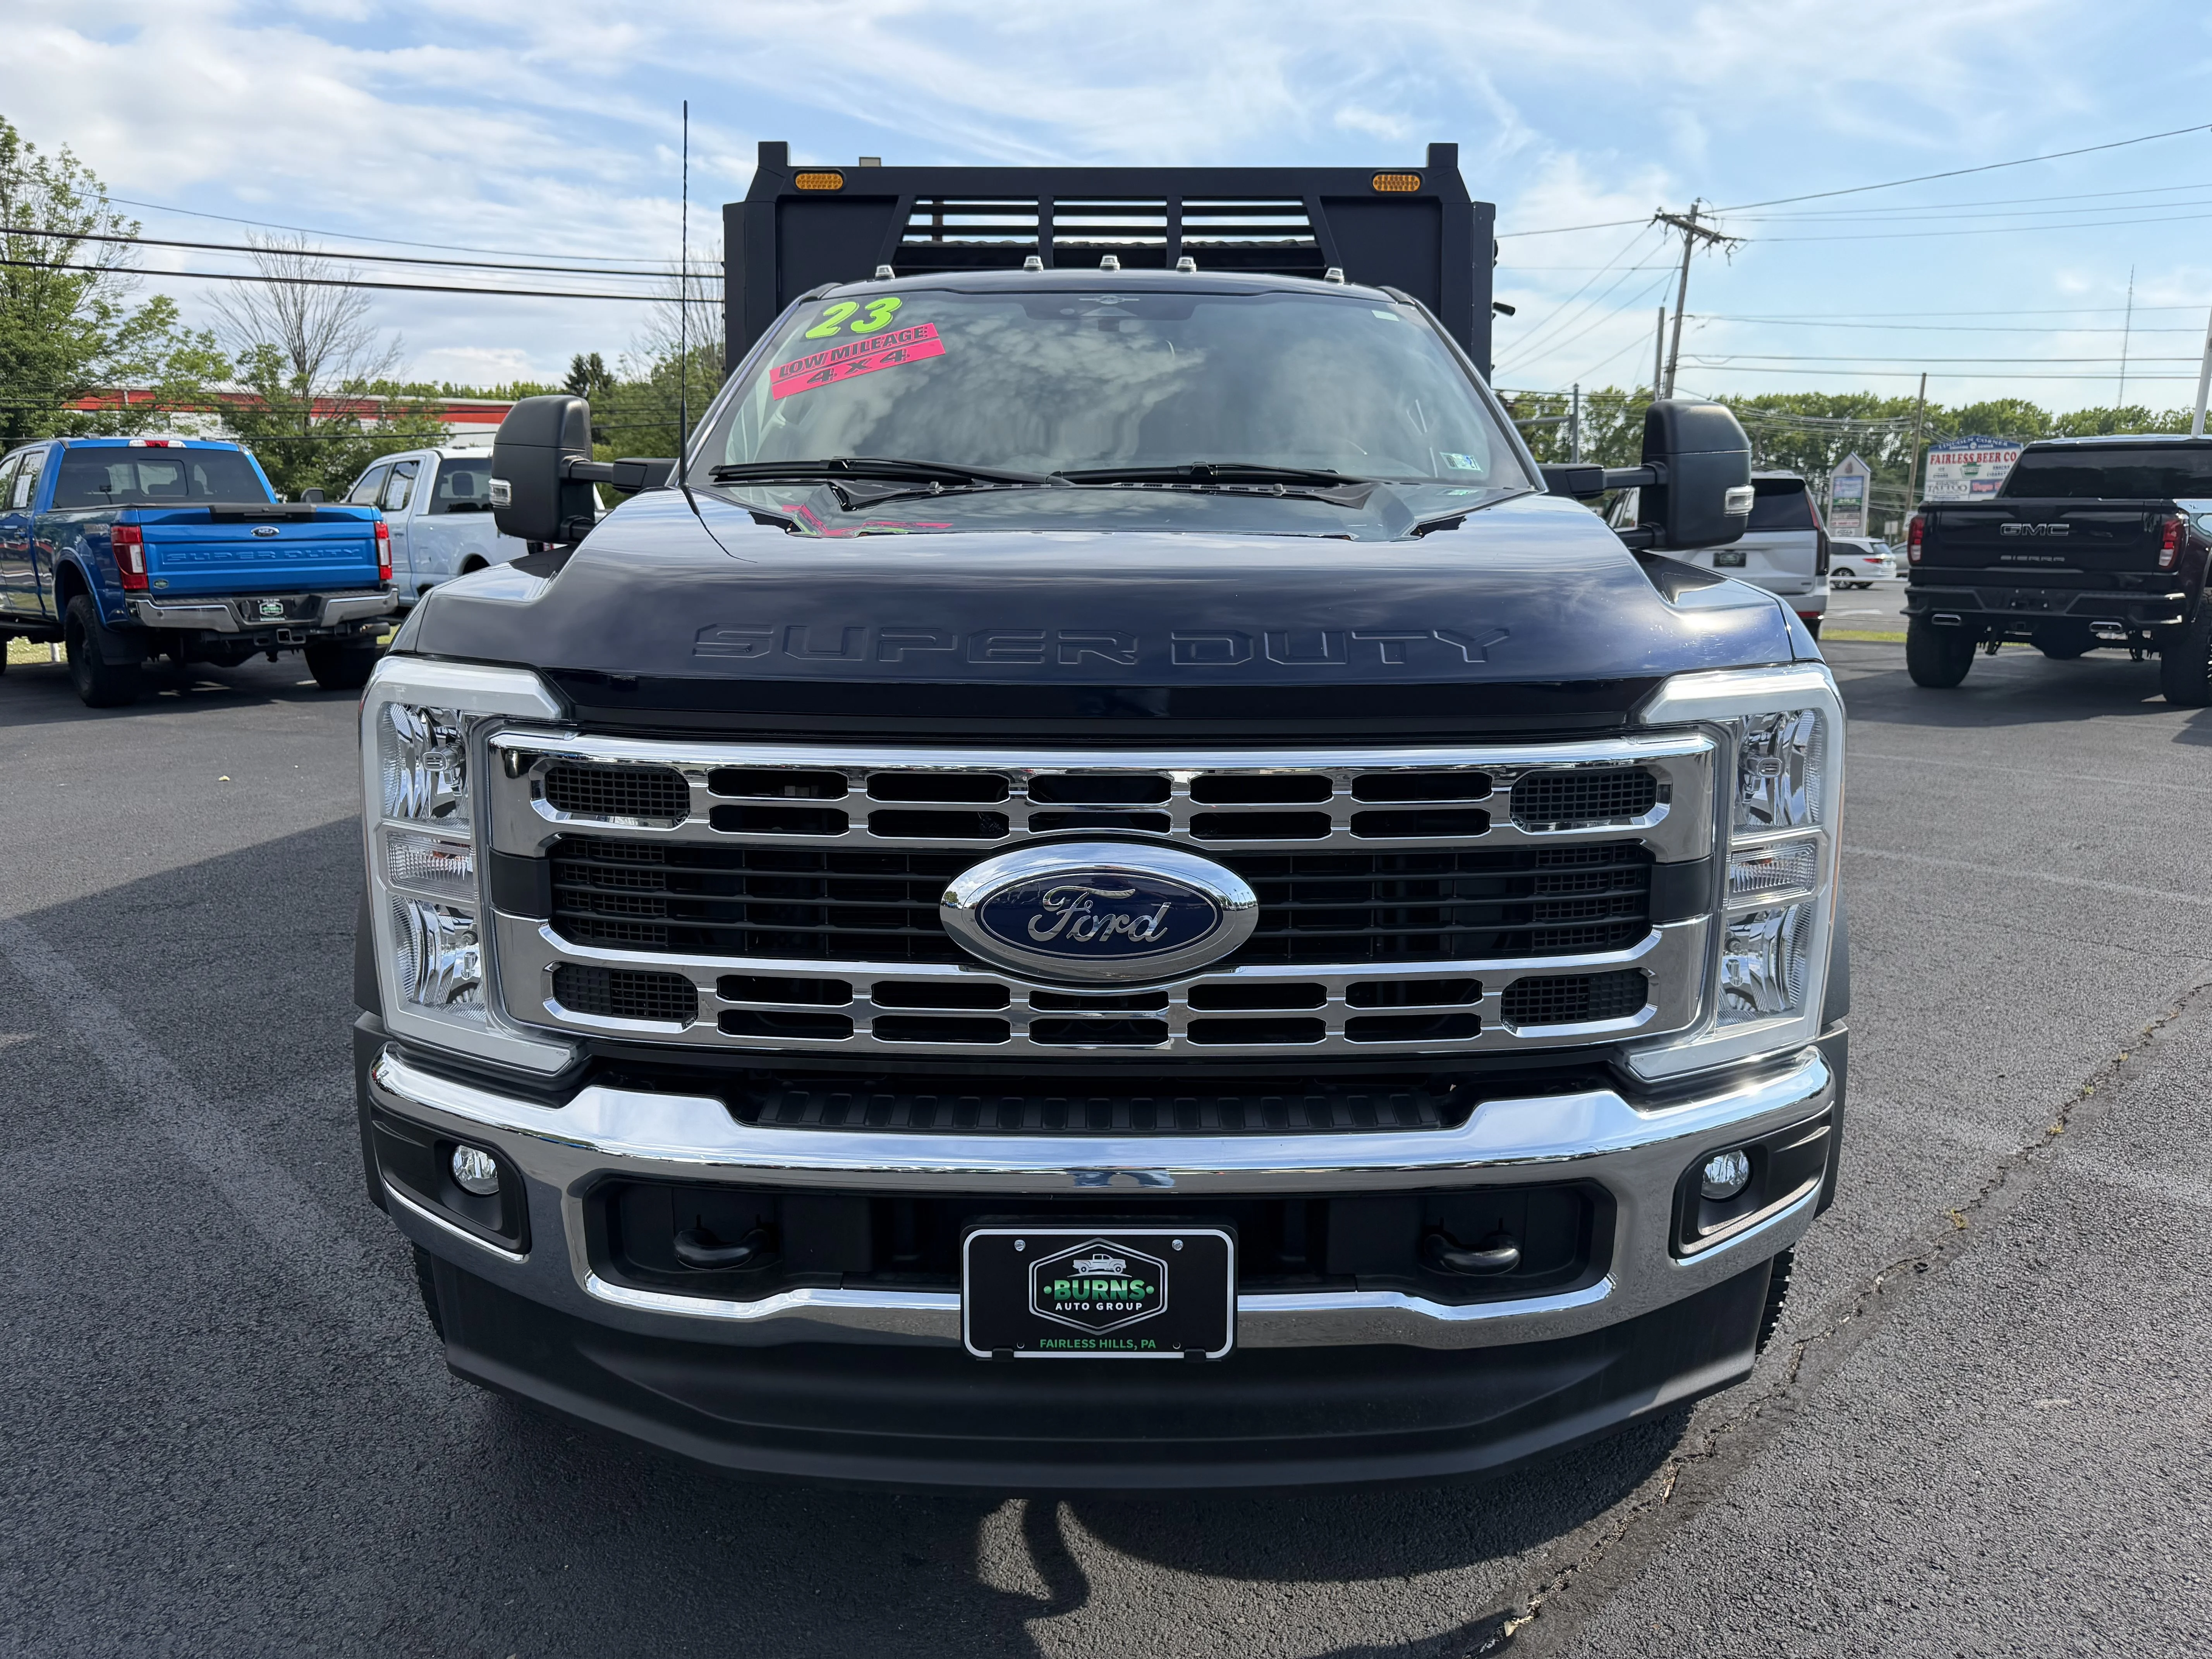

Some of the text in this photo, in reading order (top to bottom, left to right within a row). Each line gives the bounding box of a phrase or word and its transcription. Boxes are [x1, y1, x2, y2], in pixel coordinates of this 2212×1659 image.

[805, 297, 903, 339] 23
[779, 326, 928, 378] LOW MILEAGE
[1976, 436, 2008, 447] CORNER
[1930, 452, 2017, 465] FAIRLESS BEER CO
[2000, 523, 2069, 536] GMC
[167, 548, 360, 561] SUPER DUTY
[692, 623, 1510, 665] SUPER DUTY
[1028, 885, 1171, 942] Ford
[1054, 1279, 1146, 1300] BURNS
[1055, 1302, 1143, 1311] AUTO GROUP
[1040, 1339, 1156, 1350] FAIRLESS HILLS, PA
